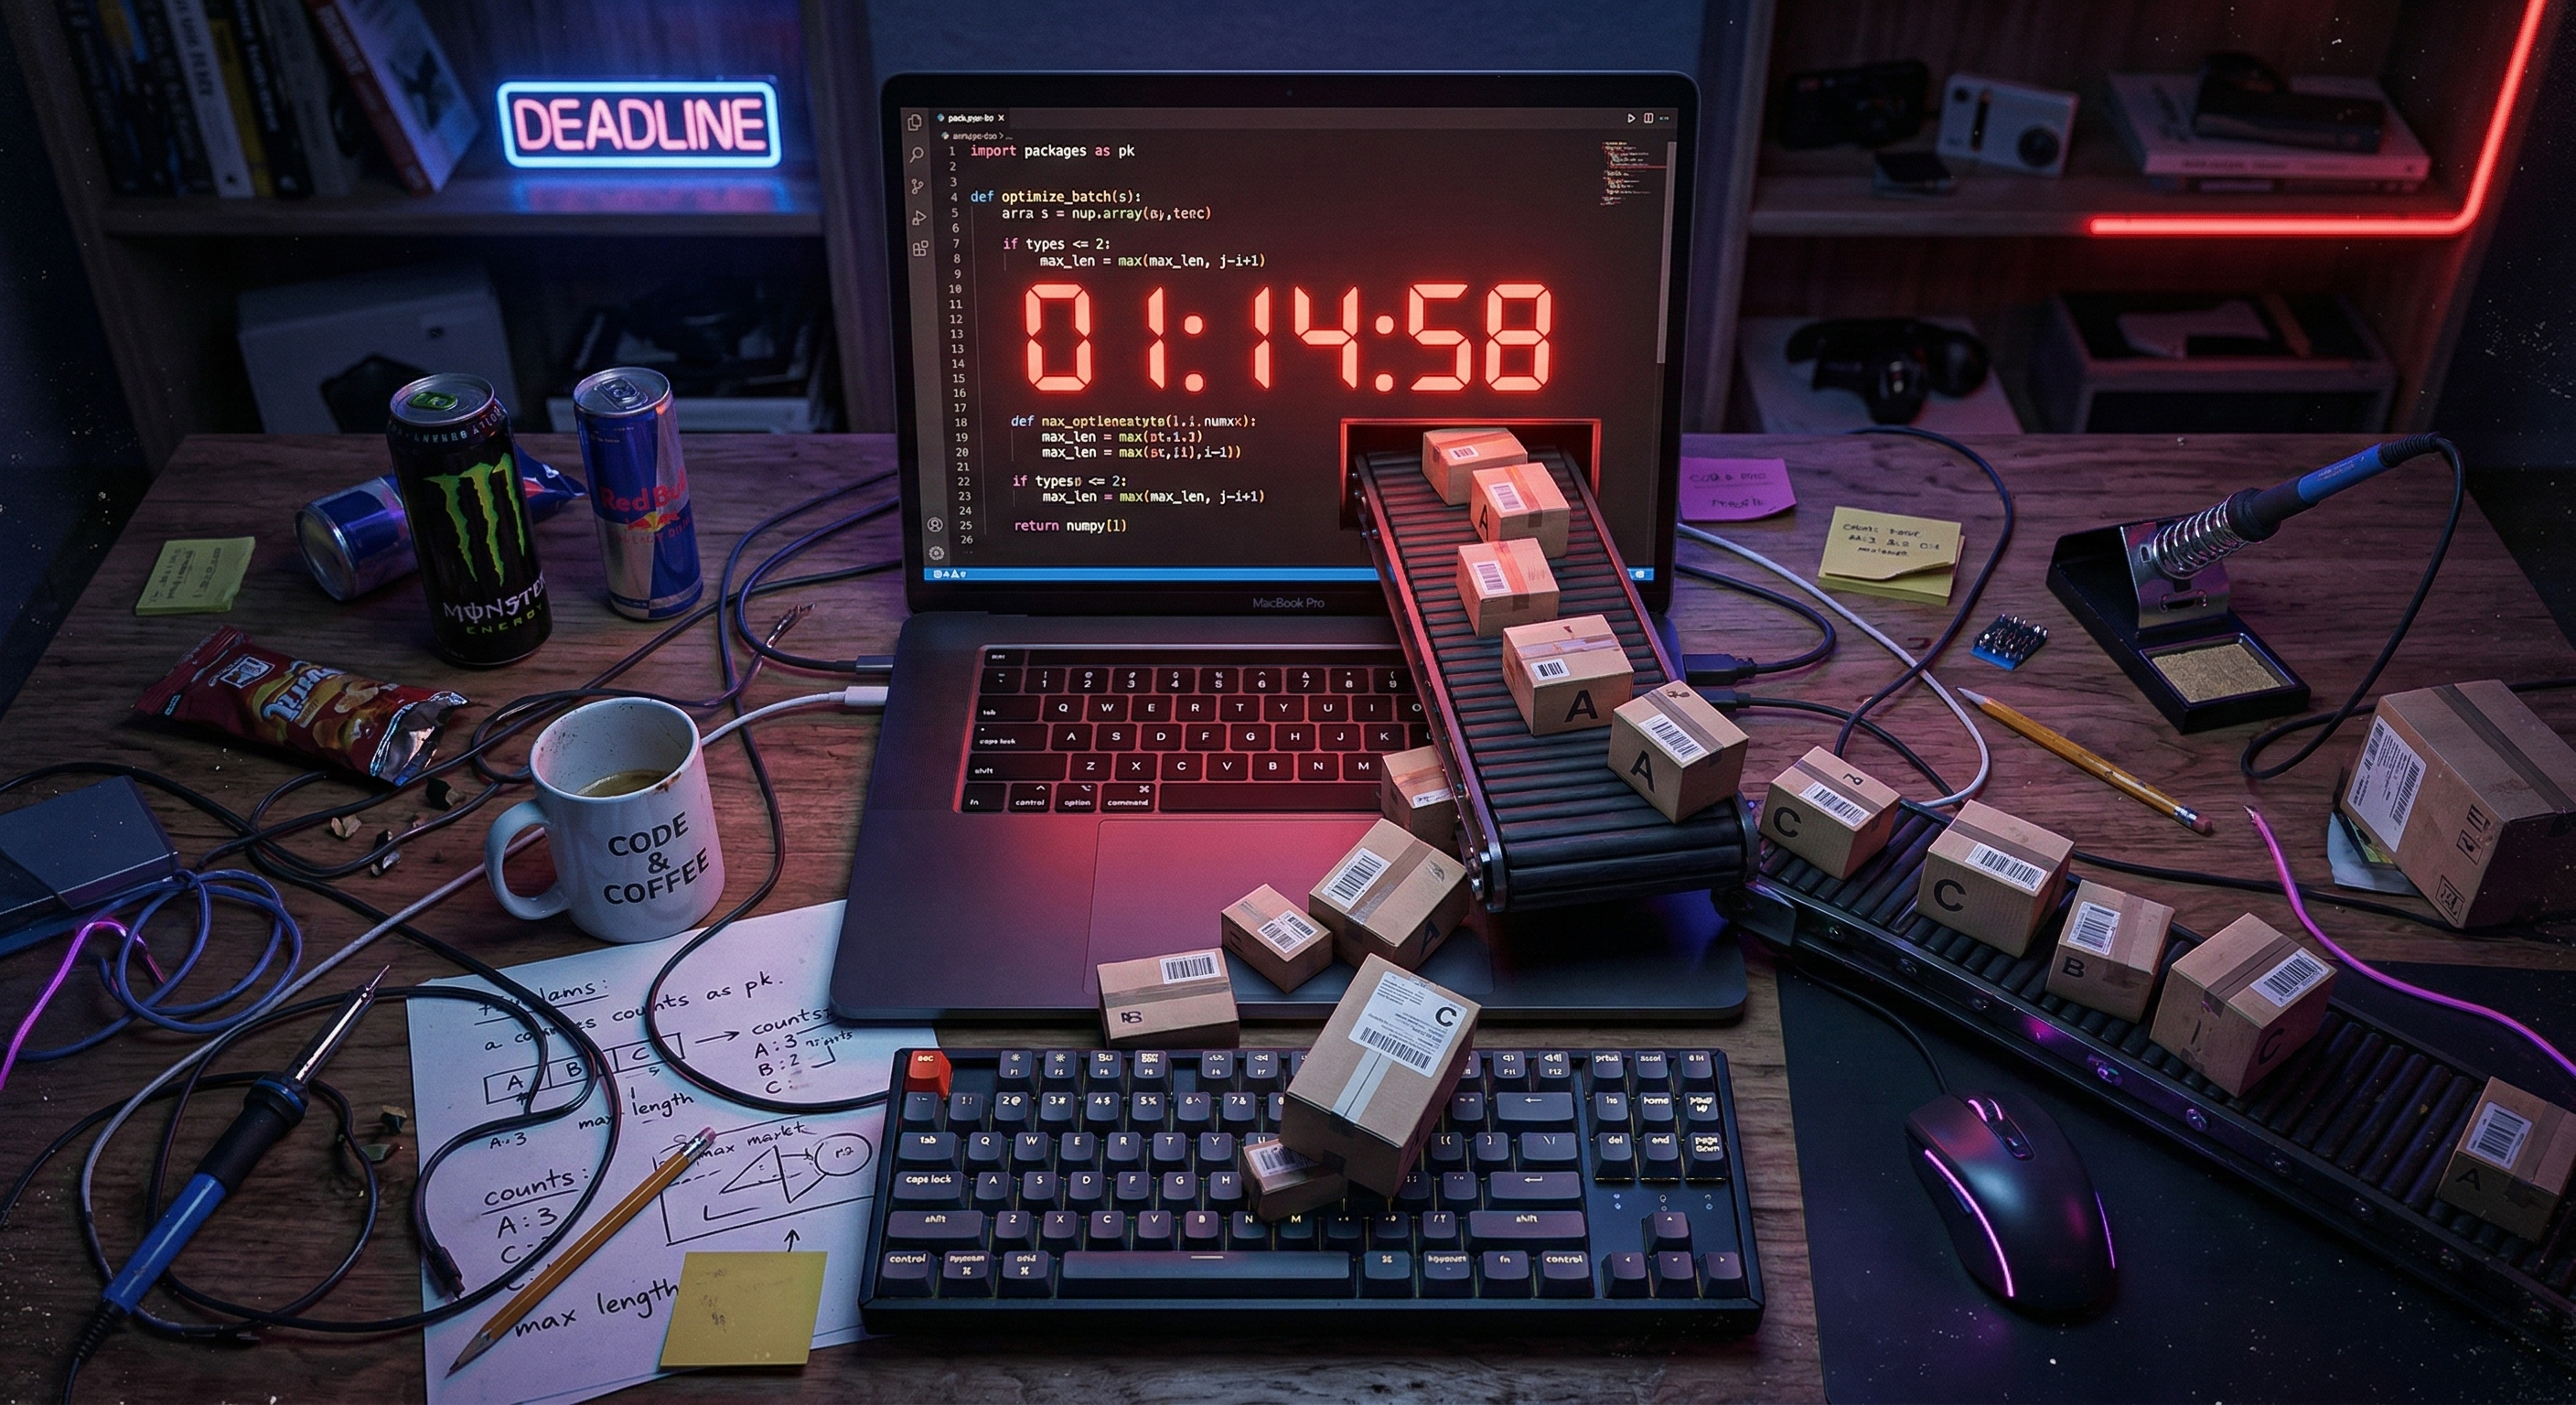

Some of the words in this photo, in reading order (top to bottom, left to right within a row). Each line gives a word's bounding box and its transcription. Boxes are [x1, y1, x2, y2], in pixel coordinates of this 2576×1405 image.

[513, 99, 767, 151] DEADLINE
[949, 145, 956, 156] 1
[971, 144, 1017, 159] import
[1025, 144, 1087, 160] packages
[1094, 146, 1111, 156] as
[1118, 144, 1135, 159] pk
[950, 161, 957, 172] 2
[950, 177, 958, 188] 3
[950, 192, 958, 202] 4
[971, 189, 994, 203] def
[1002, 189, 1141, 206] optimize_batch(s):
[951, 208, 959, 218] 5
[952, 238, 960, 249] 7
[1004, 237, 1018, 250] if
[1025, 238, 1065, 253] types
[1072, 240, 1089, 249] <=
[1095, 238, 1110, 250] 2:
[953, 253, 961, 264] 8
[1039, 253, 1096, 270] max_len
[1118, 253, 1210, 269] max(max_len,
[1219, 252, 1265, 270] j-i+1)
[954, 269, 961, 279] 9
[950, 314, 963, 325] 12
[949, 284, 962, 294] 10
[1025, 283, 1552, 392] 01:14:58
[950, 328, 964, 339] 13
[951, 359, 965, 369] 14
[953, 388, 967, 398] 16
[954, 417, 968, 427] 18
[1011, 414, 1035, 427] def
[955, 432, 969, 443] 19
[1041, 431, 1097, 445] max_len
[955, 447, 969, 457] 20
[1042, 445, 1097, 460] max_len
[957, 477, 971, 487] 22
[1013, 475, 1028, 487] if
[1088, 477, 1106, 486] <=
[1112, 475, 1126, 487] 2:
[600, 487, 650, 512] Red
[958, 491, 971, 501] 23
[1042, 489, 1098, 505] max_len
[1119, 489, 1210, 505] max(max_len,
[1219, 489, 1264, 505] j-i+1)
[960, 520, 972, 531] 25
[1014, 520, 1059, 531] return
[1479, 505, 1488, 541] A
[961, 534, 973, 544] 26
[1252, 597, 1304, 608] MacBook
[1305, 597, 1326, 608] Pro
[1058, 703, 1068, 713] Q
[1100, 703, 1114, 712] W
[1147, 703, 1155, 713] E
[1191, 703, 1200, 713] R
[1235, 703, 1244, 712] T
[1279, 703, 1289, 713] Y
[1323, 703, 1333, 713] U
[1370, 703, 1374, 712] I
[1411, 702, 1422, 713] O
[1564, 690, 1599, 723] A
[1066, 732, 1077, 741] A
[1111, 732, 1121, 741] S
[1156, 732, 1166, 741] D
[1202, 732, 1209, 741] F
[1245, 732, 1255, 741] G
[1291, 732, 1300, 741] H
[1336, 732, 1344, 741] J
[1379, 732, 1390, 741] K
[1086, 761, 1096, 770] Z
[1132, 761, 1141, 771] X
[1176, 761, 1186, 771] C
[1222, 761, 1232, 771] V
[1269, 761, 1278, 770] B
[1314, 761, 1324, 770] N
[1358, 761, 1369, 770] M
[1630, 750, 1656, 794] A
[1773, 807, 1801, 838] C
[607, 811, 690, 857] CODE
[648, 853, 671, 874] &
[603, 847, 710, 906] COFFEE
[1933, 879, 1967, 913] C
[2062, 956, 2085, 979] B
[706, 985, 732, 1001] as
[1435, 1006, 1457, 1027] C
[2259, 1028, 2285, 1066] C
[507, 1074, 524, 1091] A
[565, 1061, 583, 1078] B
[631, 1046, 650, 1061] C
[632, 1092, 694, 1118] length
[981, 1136, 990, 1146] Q
[1025, 1136, 1038, 1145] W
[1074, 1136, 1080, 1145] E
[1120, 1136, 1127, 1146] R
[1165, 1136, 1174, 1145] T
[1211, 1136, 1220, 1146] Y
[1608, 1135, 1624, 1144] del
[1651, 1135, 1670, 1144] end
[484, 1168, 589, 1207] counts:
[930, 1174, 951, 1184] lock
[988, 1175, 998, 1185] A
[1036, 1175, 1043, 1185] S
[1082, 1175, 1091, 1185] D
[1129, 1175, 1136, 1185] F
[1175, 1175, 1185, 1185] G
[2455, 1167, 2481, 1192] A
[1056, 1215, 1064, 1223] X
[1103, 1215, 1111, 1224] C
[1150, 1215, 1159, 1223] V
[1198, 1215, 1206, 1223] B
[1245, 1215, 1253, 1224] N
[1291, 1215, 1302, 1223] M
[889, 1253, 927, 1263] control
[1499, 1255, 1511, 1263] fn
[1545, 1254, 1583, 1263] control
[516, 1310, 577, 1338] max
[596, 1281, 678, 1318] length
